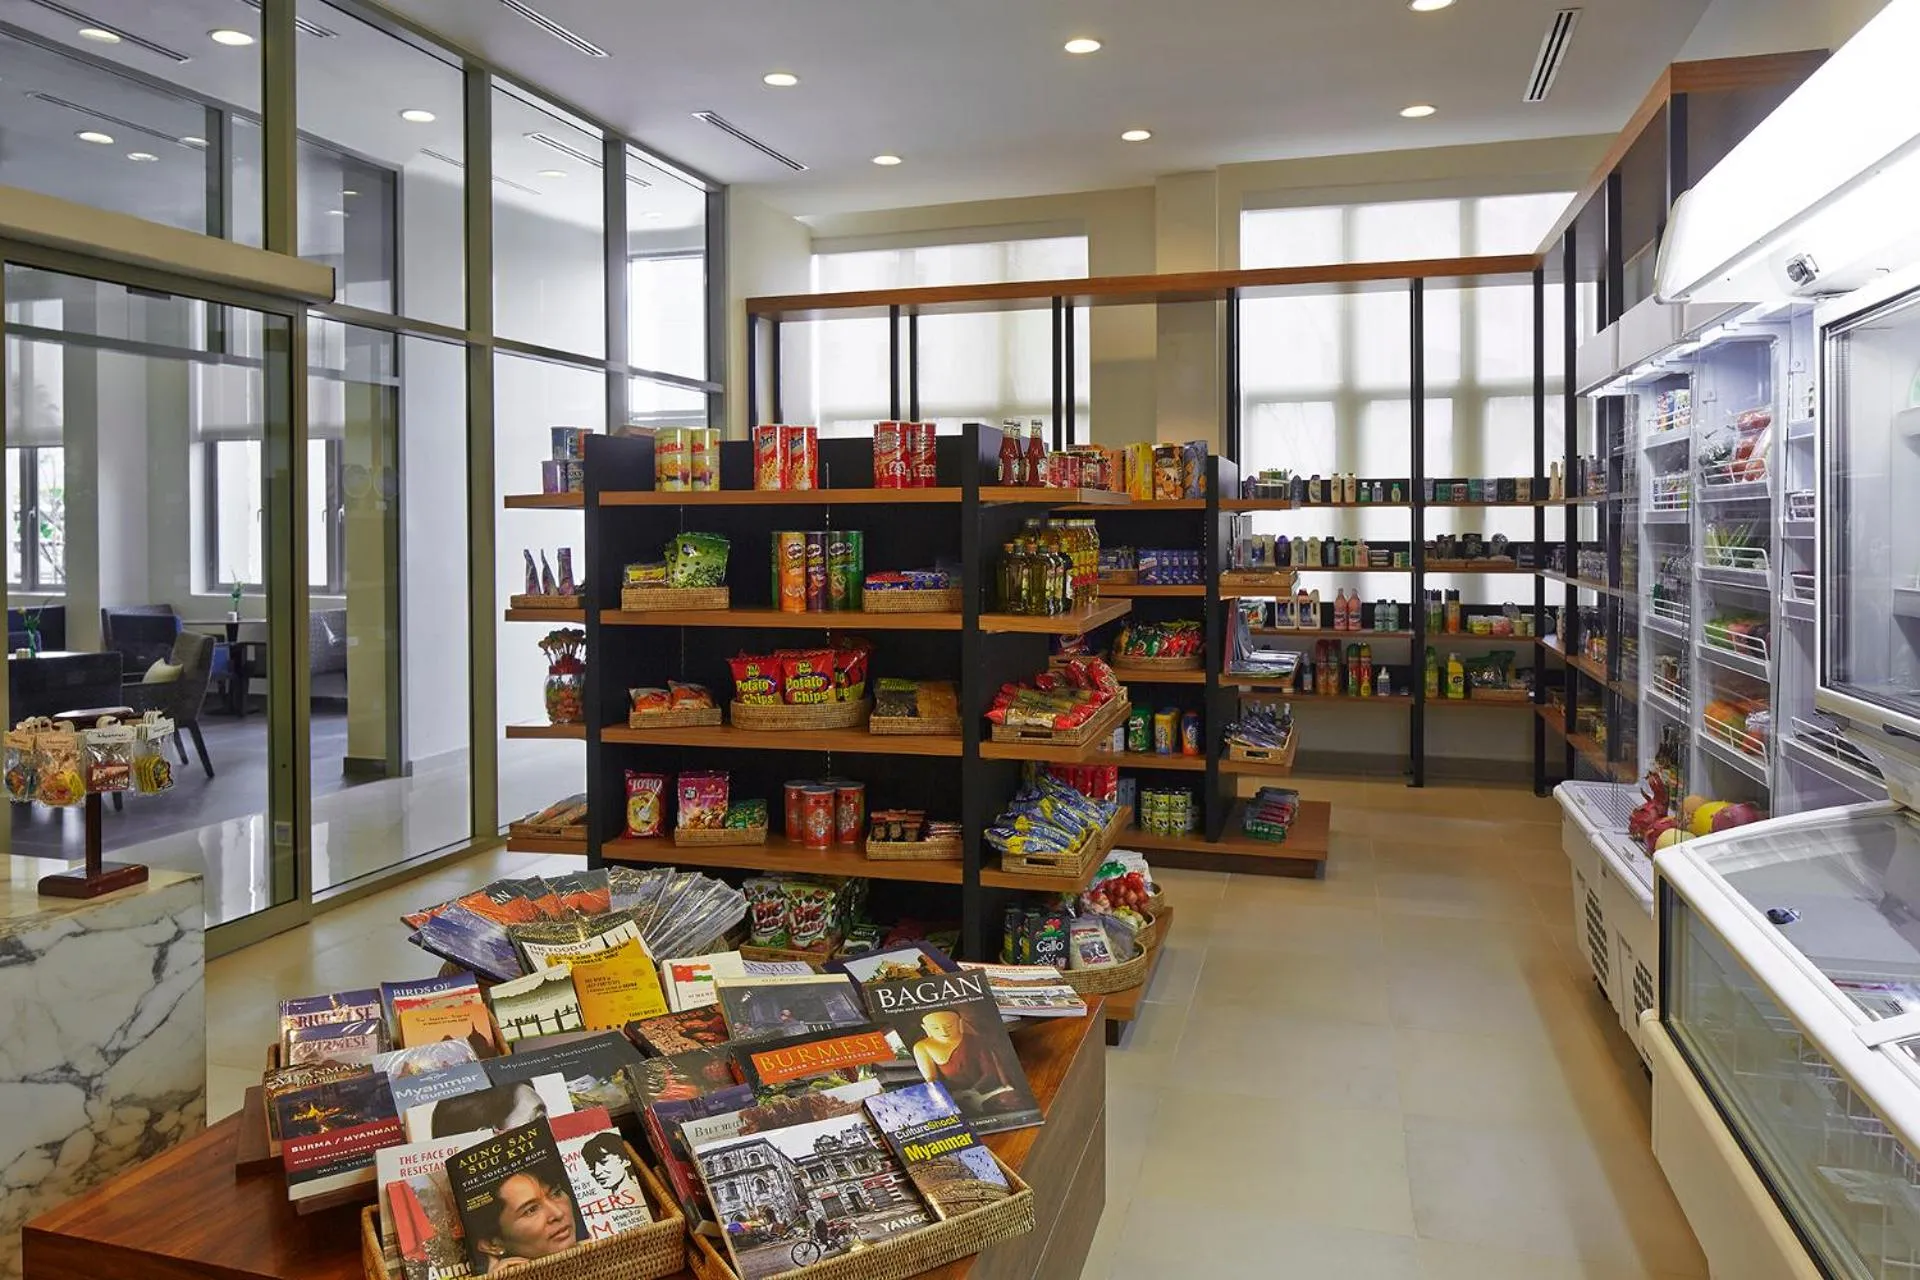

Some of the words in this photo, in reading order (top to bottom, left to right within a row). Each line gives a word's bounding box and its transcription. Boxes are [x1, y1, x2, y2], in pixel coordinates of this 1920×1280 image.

[736, 679, 769, 692] Potato
[786, 676, 823, 690] Potato
[794, 690, 829, 704] Chips
[547, 944, 576, 953] FOOD
[1036, 940, 1065, 953] Gallo
[393, 985, 431, 997] BIRDS
[876, 975, 984, 1008] BAGAN
[760, 1035, 885, 1072] BURMESE
[395, 1074, 480, 1101] Myanmar
[291, 1140, 333, 1154] BURMA
[343, 1124, 399, 1143] MYANMAR
[457, 1144, 502, 1170] AUNG
[508, 1128, 539, 1147] SAN
[903, 1132, 974, 1163] Myanmar
[399, 1153, 419, 1166] THE
[421, 1150, 445, 1163] FACE
[468, 1156, 500, 1175] SUU
[507, 1141, 537, 1160] KYI
[461, 1178, 478, 1189] THE
[481, 1166, 508, 1179] VOICE
